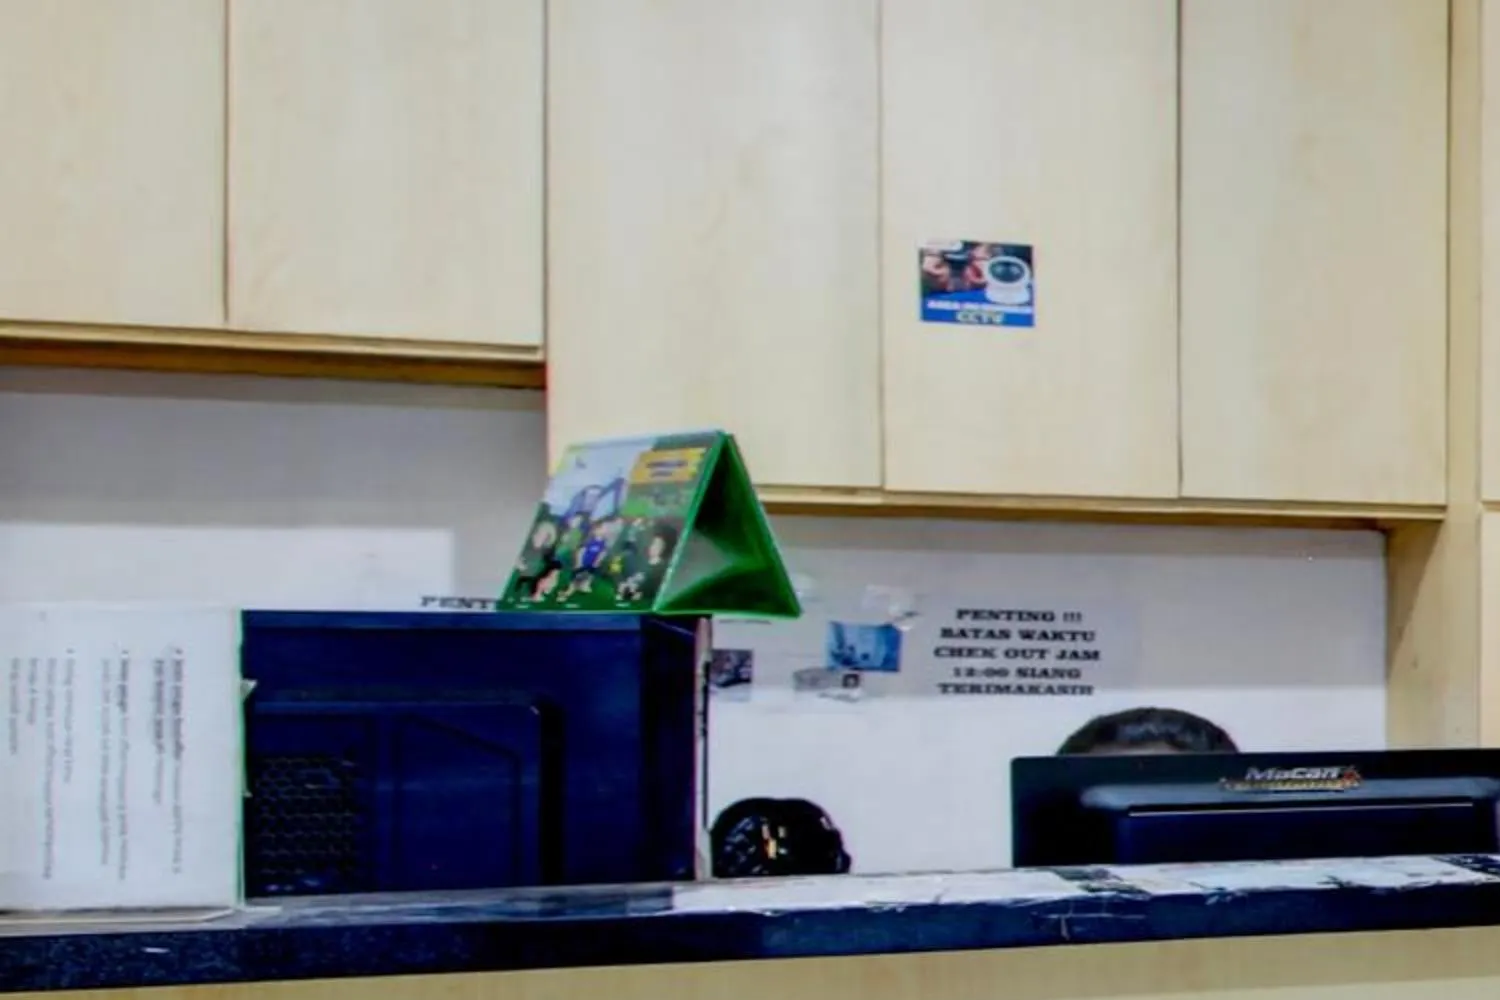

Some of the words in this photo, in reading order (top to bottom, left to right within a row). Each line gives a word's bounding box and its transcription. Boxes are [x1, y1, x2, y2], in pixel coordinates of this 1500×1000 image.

[421, 595, 497, 609] PENT
[956, 608, 1055, 622] PENTING
[940, 627, 1011, 640] BATAS
[1018, 629, 1096, 642] WAKTU
[934, 647, 997, 659] CHEK
[1004, 648, 1049, 660] OUT
[1056, 649, 1101, 661] JAM
[953, 667, 1009, 678] 12:00
[1016, 667, 1081, 679] SIANG
[938, 683, 1095, 695] TERIMAKASIH
